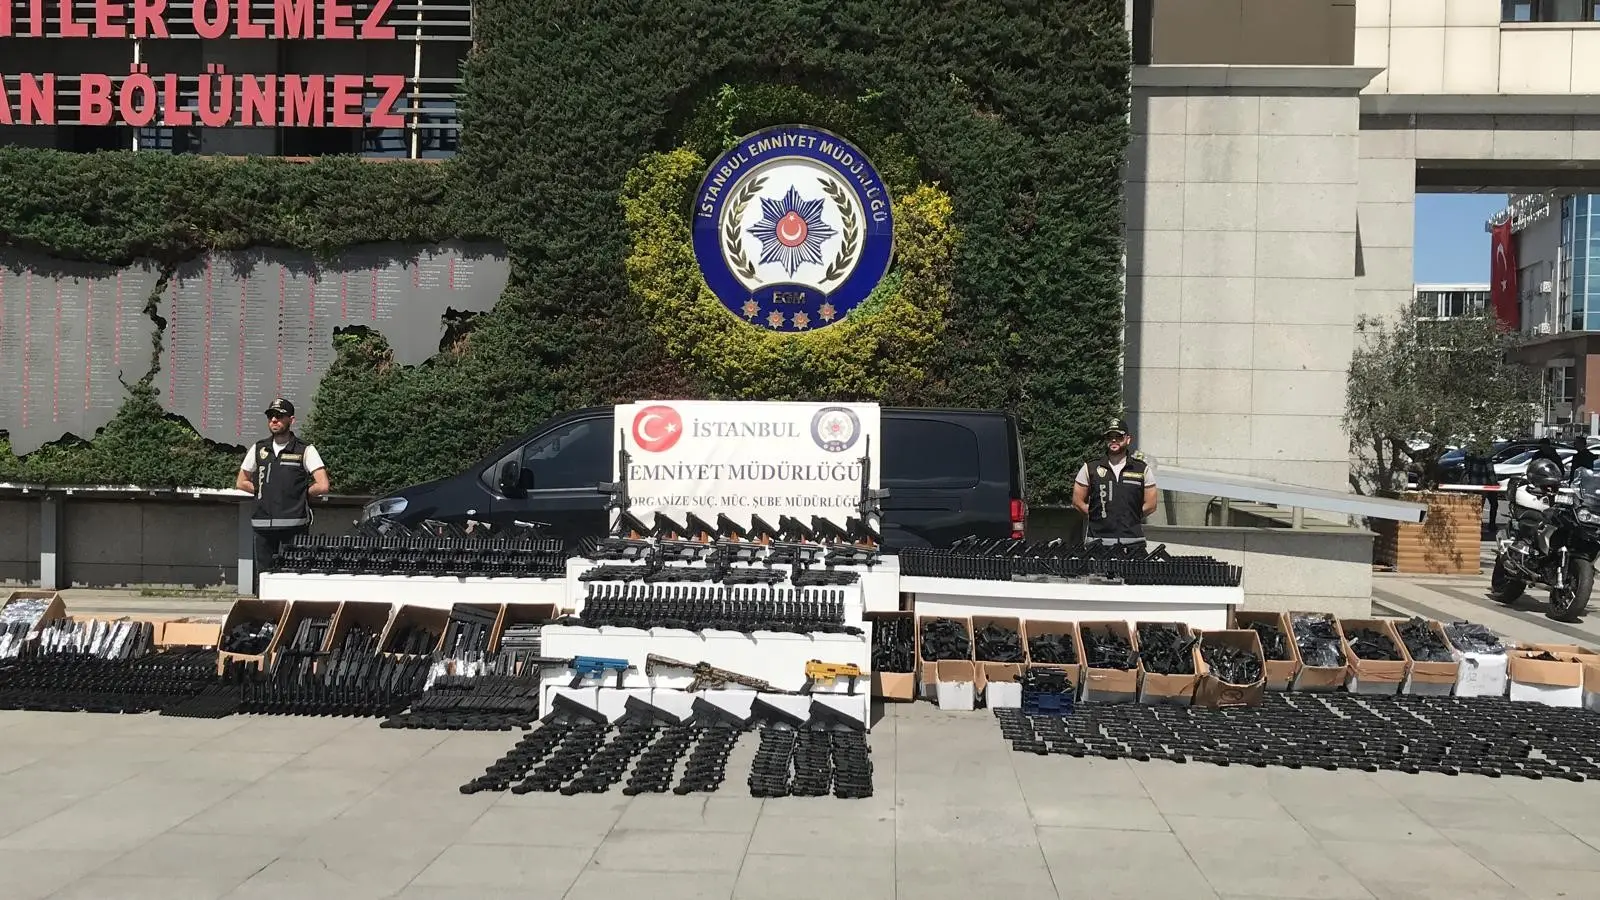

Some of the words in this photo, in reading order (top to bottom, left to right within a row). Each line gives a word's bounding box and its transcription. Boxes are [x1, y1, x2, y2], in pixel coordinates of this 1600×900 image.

[80, 63, 405, 128] BÖLÜNMEZ
[698, 152, 749, 218] İSTANBUL
[749, 133, 816, 157] EMNİYET
[773, 291, 806, 304] EGM
[692, 418, 801, 438] İSTANBUL
[630, 460, 724, 481] EMNİYET
[727, 460, 861, 482] MÜDÜRLÜĞÜ
